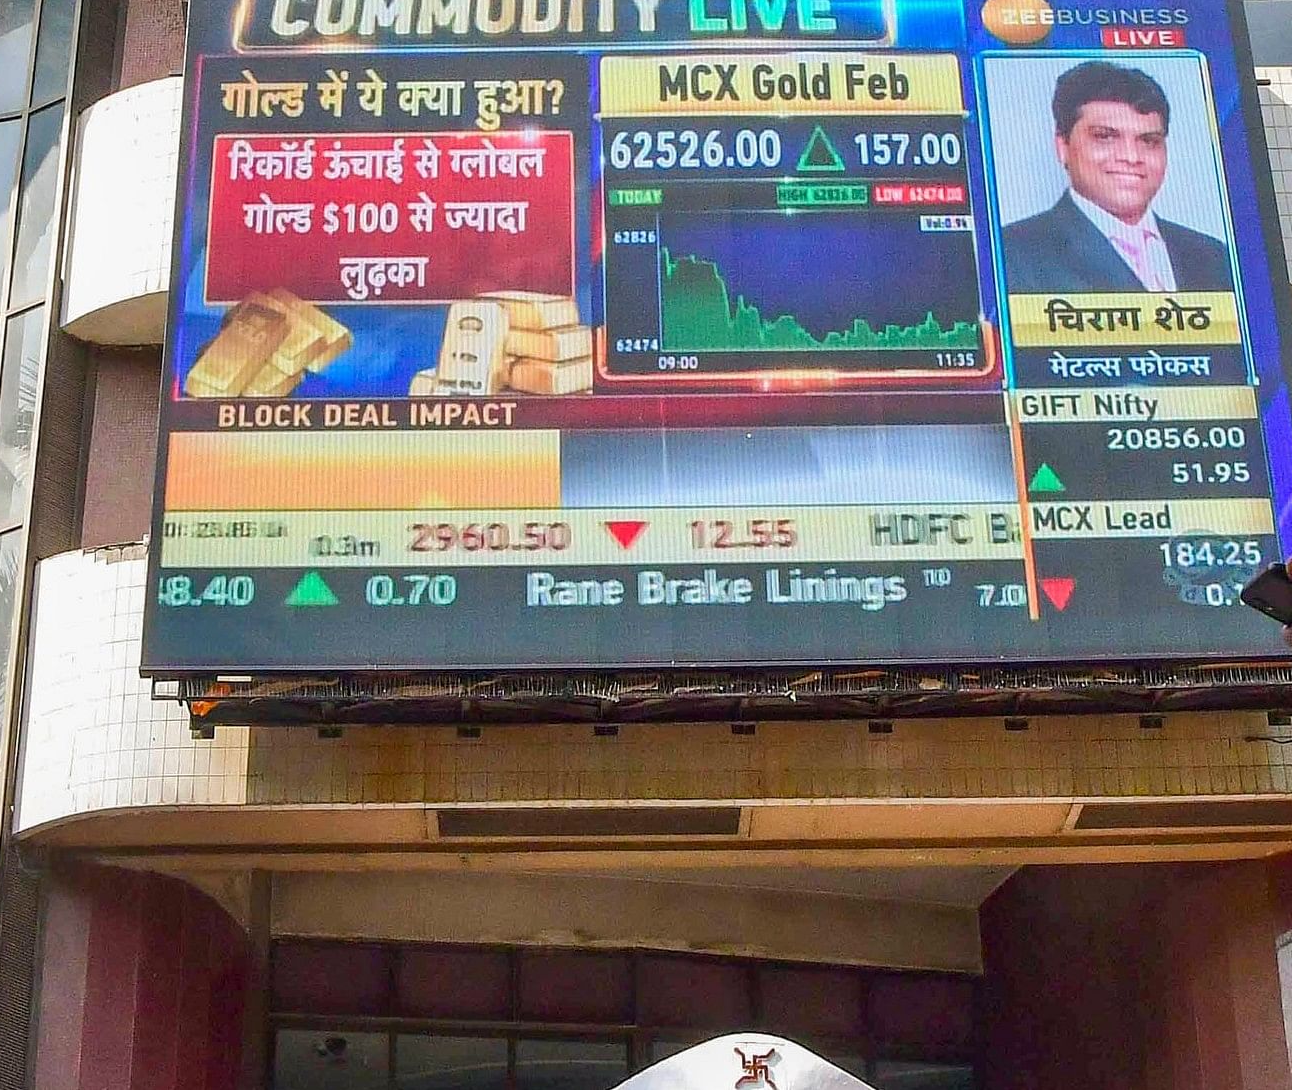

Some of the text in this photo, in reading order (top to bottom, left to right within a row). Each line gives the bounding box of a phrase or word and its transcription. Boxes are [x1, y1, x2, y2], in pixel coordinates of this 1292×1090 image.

[1113, 30, 1176, 46] LIVE
[659, 61, 909, 101] MCX Gold Feb
[221, 69, 565, 129] गोल्ड में ये क्या हुआ?
[229, 140, 545, 184] रिकॉर्ड ऊंचाई से ग्लोबल
[610, 129, 961, 169] 62526.00 157.00
[616, 189, 662, 206] TODAY
[779, 189, 807, 201] HIGH
[875, 187, 903, 202] LOW
[243, 192, 528, 234] गोल्ड $100 से ज्यादा
[614, 231, 657, 244] 62826
[339, 256, 429, 301] लुढ़का
[1044, 297, 1212, 332] चिराग शेठ
[616, 338, 658, 352] 62474
[658, 353, 975, 370] 09:00 11:35
[1049, 350, 1212, 378] मेटल्स फोकस
[218, 402, 517, 428] BLOCK DEAL IMPACT
[1021, 393, 1158, 421] GIFT Nifty
[1108, 427, 1245, 450] 20856.00
[1172, 462, 1250, 483] 51.95
[1034, 505, 1172, 532] MCX Lead
[410, 521, 572, 552] 2960.50
[689, 519, 798, 549] 12.55
[870, 513, 974, 545] HDFC
[1160, 541, 1261, 567] 184.25
[364, 575, 458, 606] 0.70
[526, 572, 624, 607] Rane
[637, 569, 752, 605] Brake
[765, 567, 908, 610] Linings
